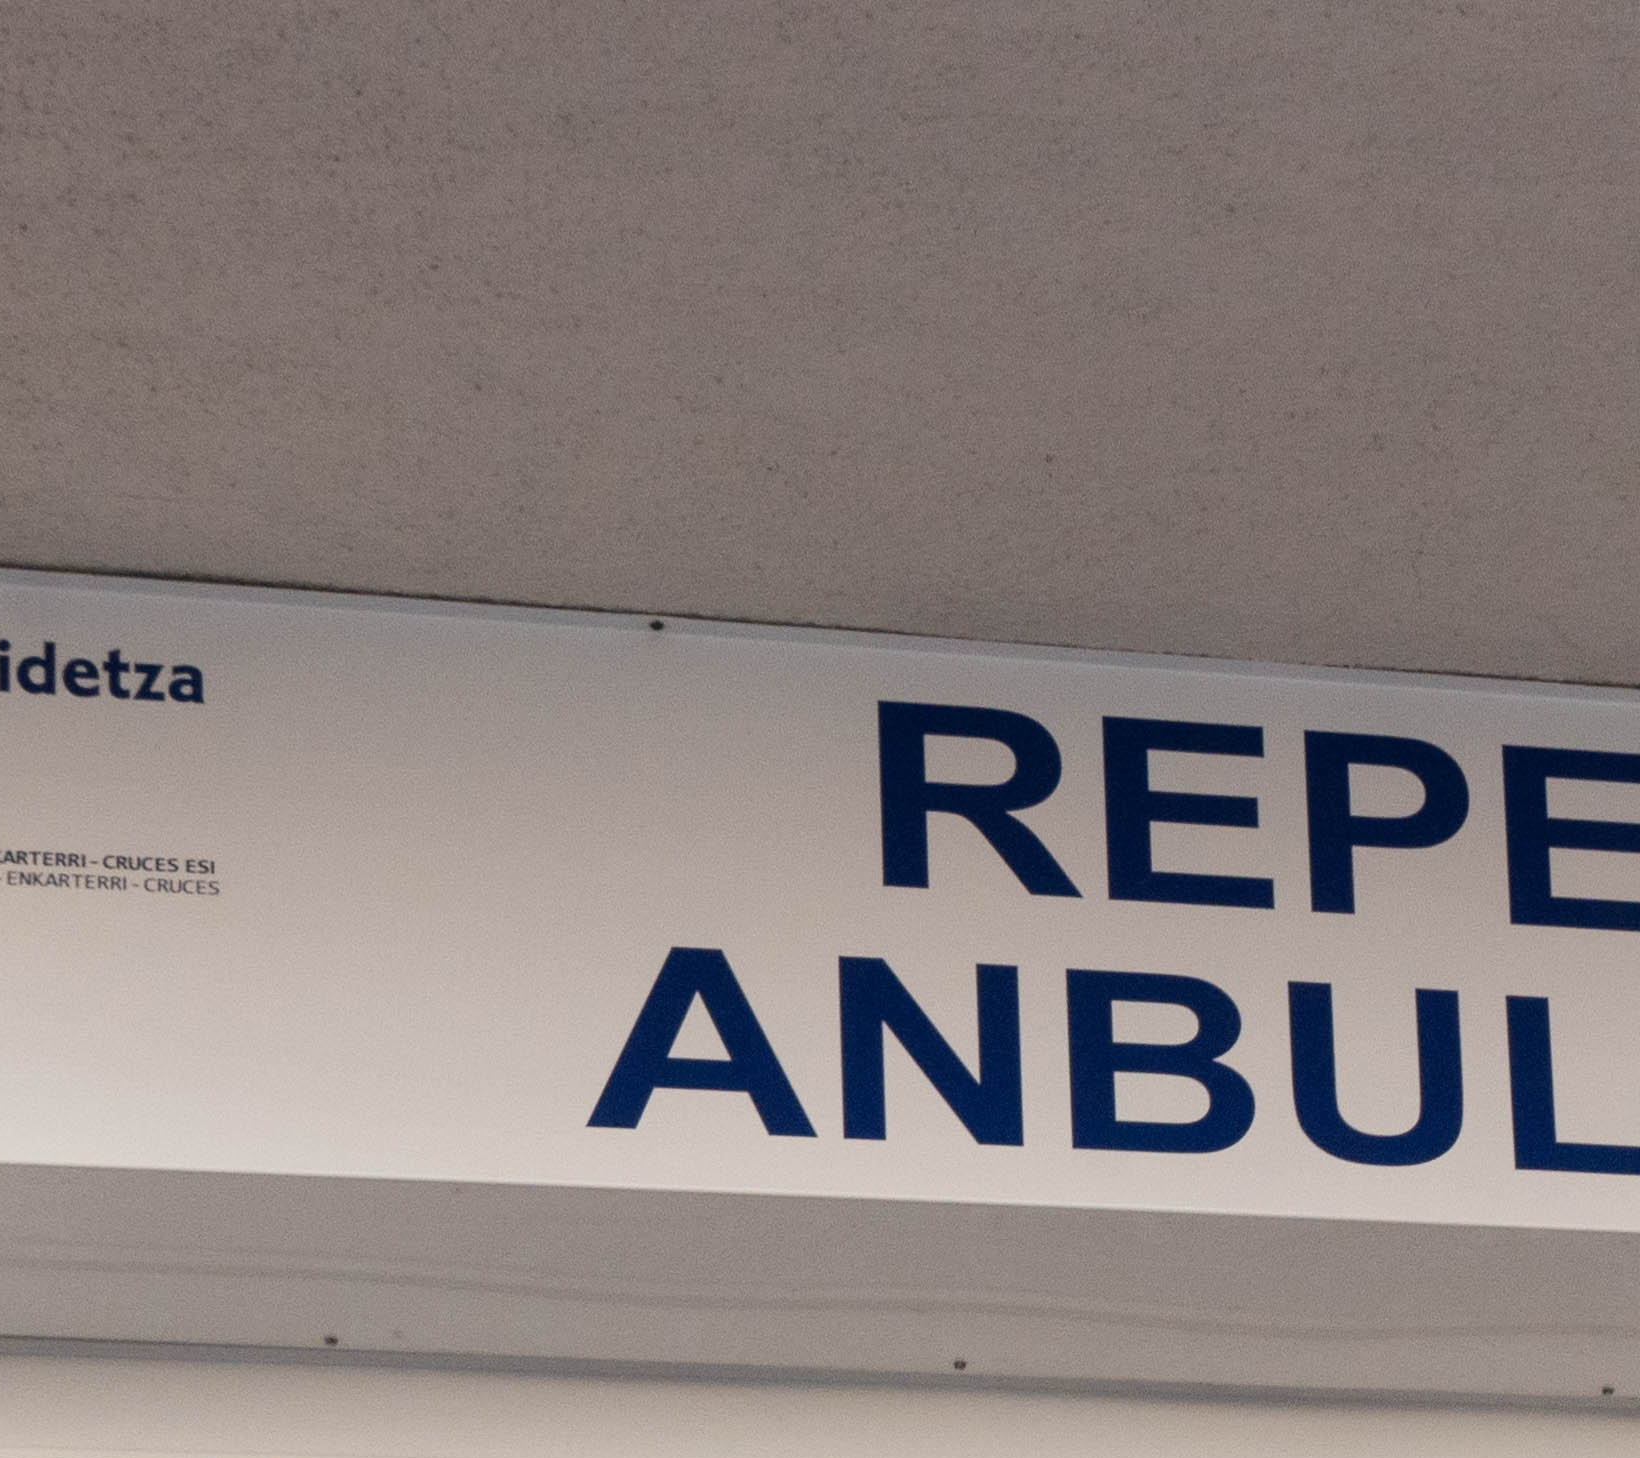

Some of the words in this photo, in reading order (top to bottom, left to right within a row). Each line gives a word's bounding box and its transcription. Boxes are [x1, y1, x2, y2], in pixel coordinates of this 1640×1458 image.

[103, 854, 179, 873] CRUCES
[185, 859, 217, 874] ESI
[6, 870, 128, 891] ENKARTERRI
[143, 877, 220, 896] CRUCES
